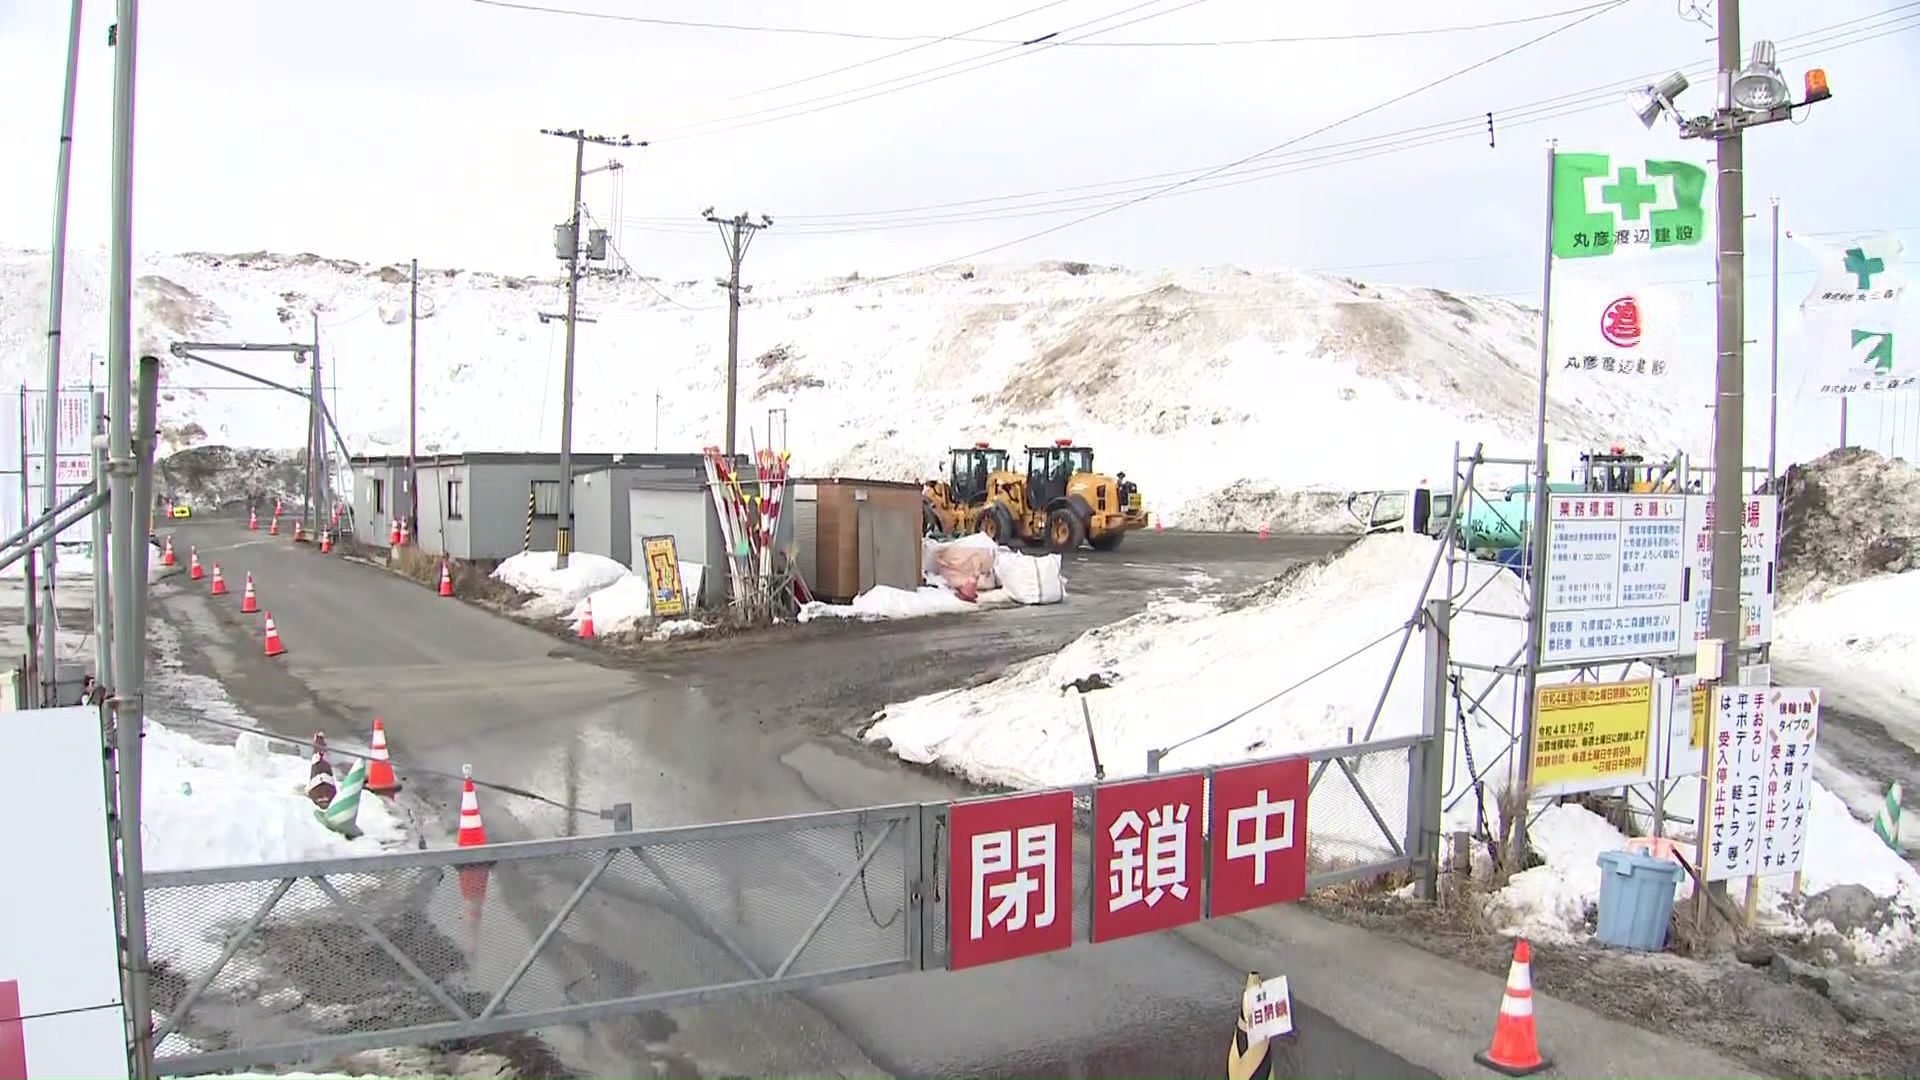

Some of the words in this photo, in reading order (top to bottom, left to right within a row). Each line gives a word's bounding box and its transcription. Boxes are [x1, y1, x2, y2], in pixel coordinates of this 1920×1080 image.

[1573, 226, 1694, 248] 丸彦渡辺建設
[1564, 355, 1668, 376] 丸彦渡辺建設
[1633, 501, 1673, 517] お願い
[1779, 701, 1812, 715] 後輪1軸
[1779, 719, 1809, 733] タイプの
[1781, 744, 1796, 830] 深箱ダンプ
[1763, 744, 1781, 867] 受入停止中です
[1792, 744, 1810, 863] ファームダンプ
[970, 789, 1296, 941] 閉鎖中
[1777, 851, 1786, 866] は
